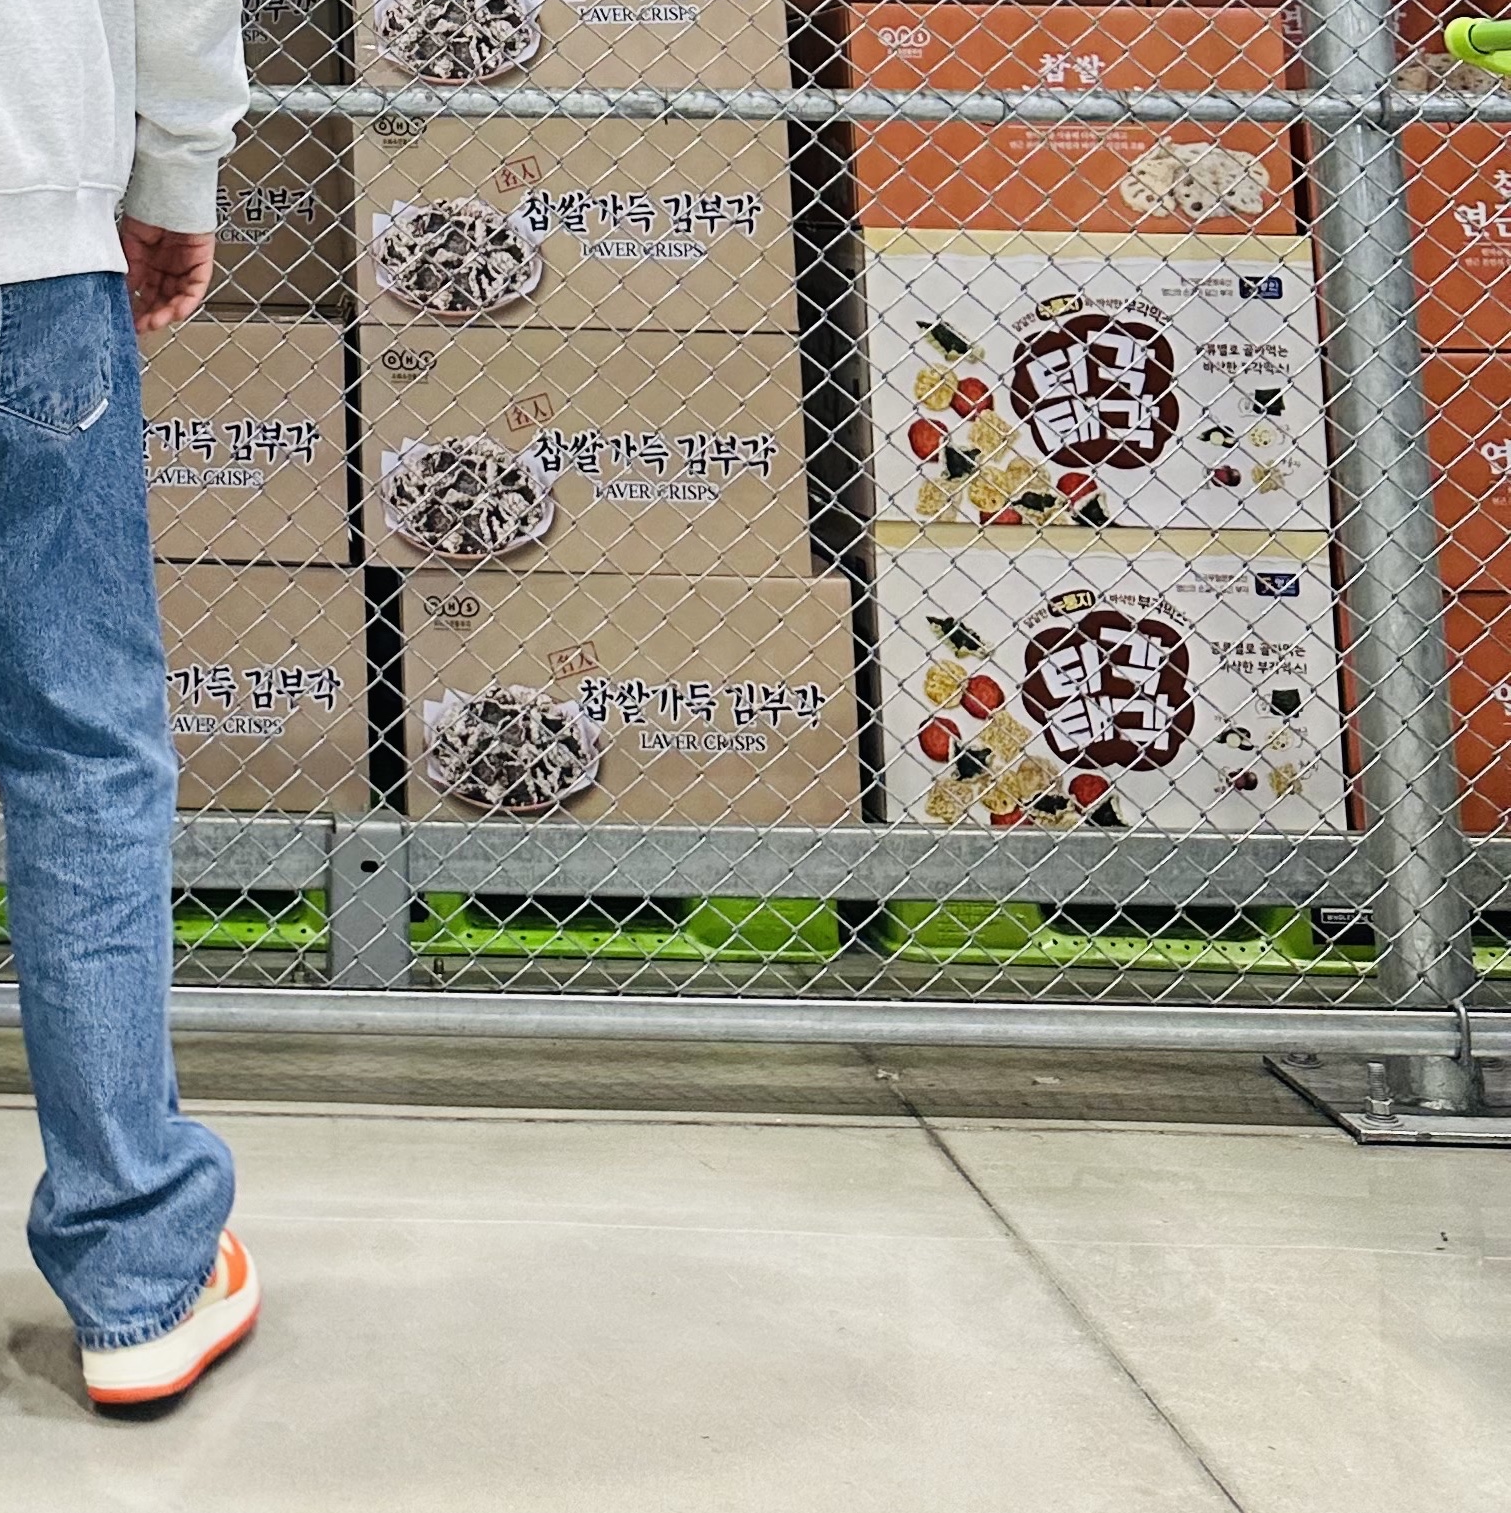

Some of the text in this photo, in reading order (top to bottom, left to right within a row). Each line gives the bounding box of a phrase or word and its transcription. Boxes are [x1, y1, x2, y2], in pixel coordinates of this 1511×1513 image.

[1037, 53, 1105, 84] 찹쌀
[241, 187, 317, 225] 김부각
[522, 191, 762, 236] 찹쌀가득 김부각
[225, 420, 319, 464] 김부각
[534, 430, 777, 476] 찹쌀가득 김부각
[244, 665, 343, 711] 김부각
[578, 678, 826, 729] 찹쌀가득 김부각
[222, 716, 285, 736] CRISPS
[640, 732, 767, 753] LAVER CRISPS
